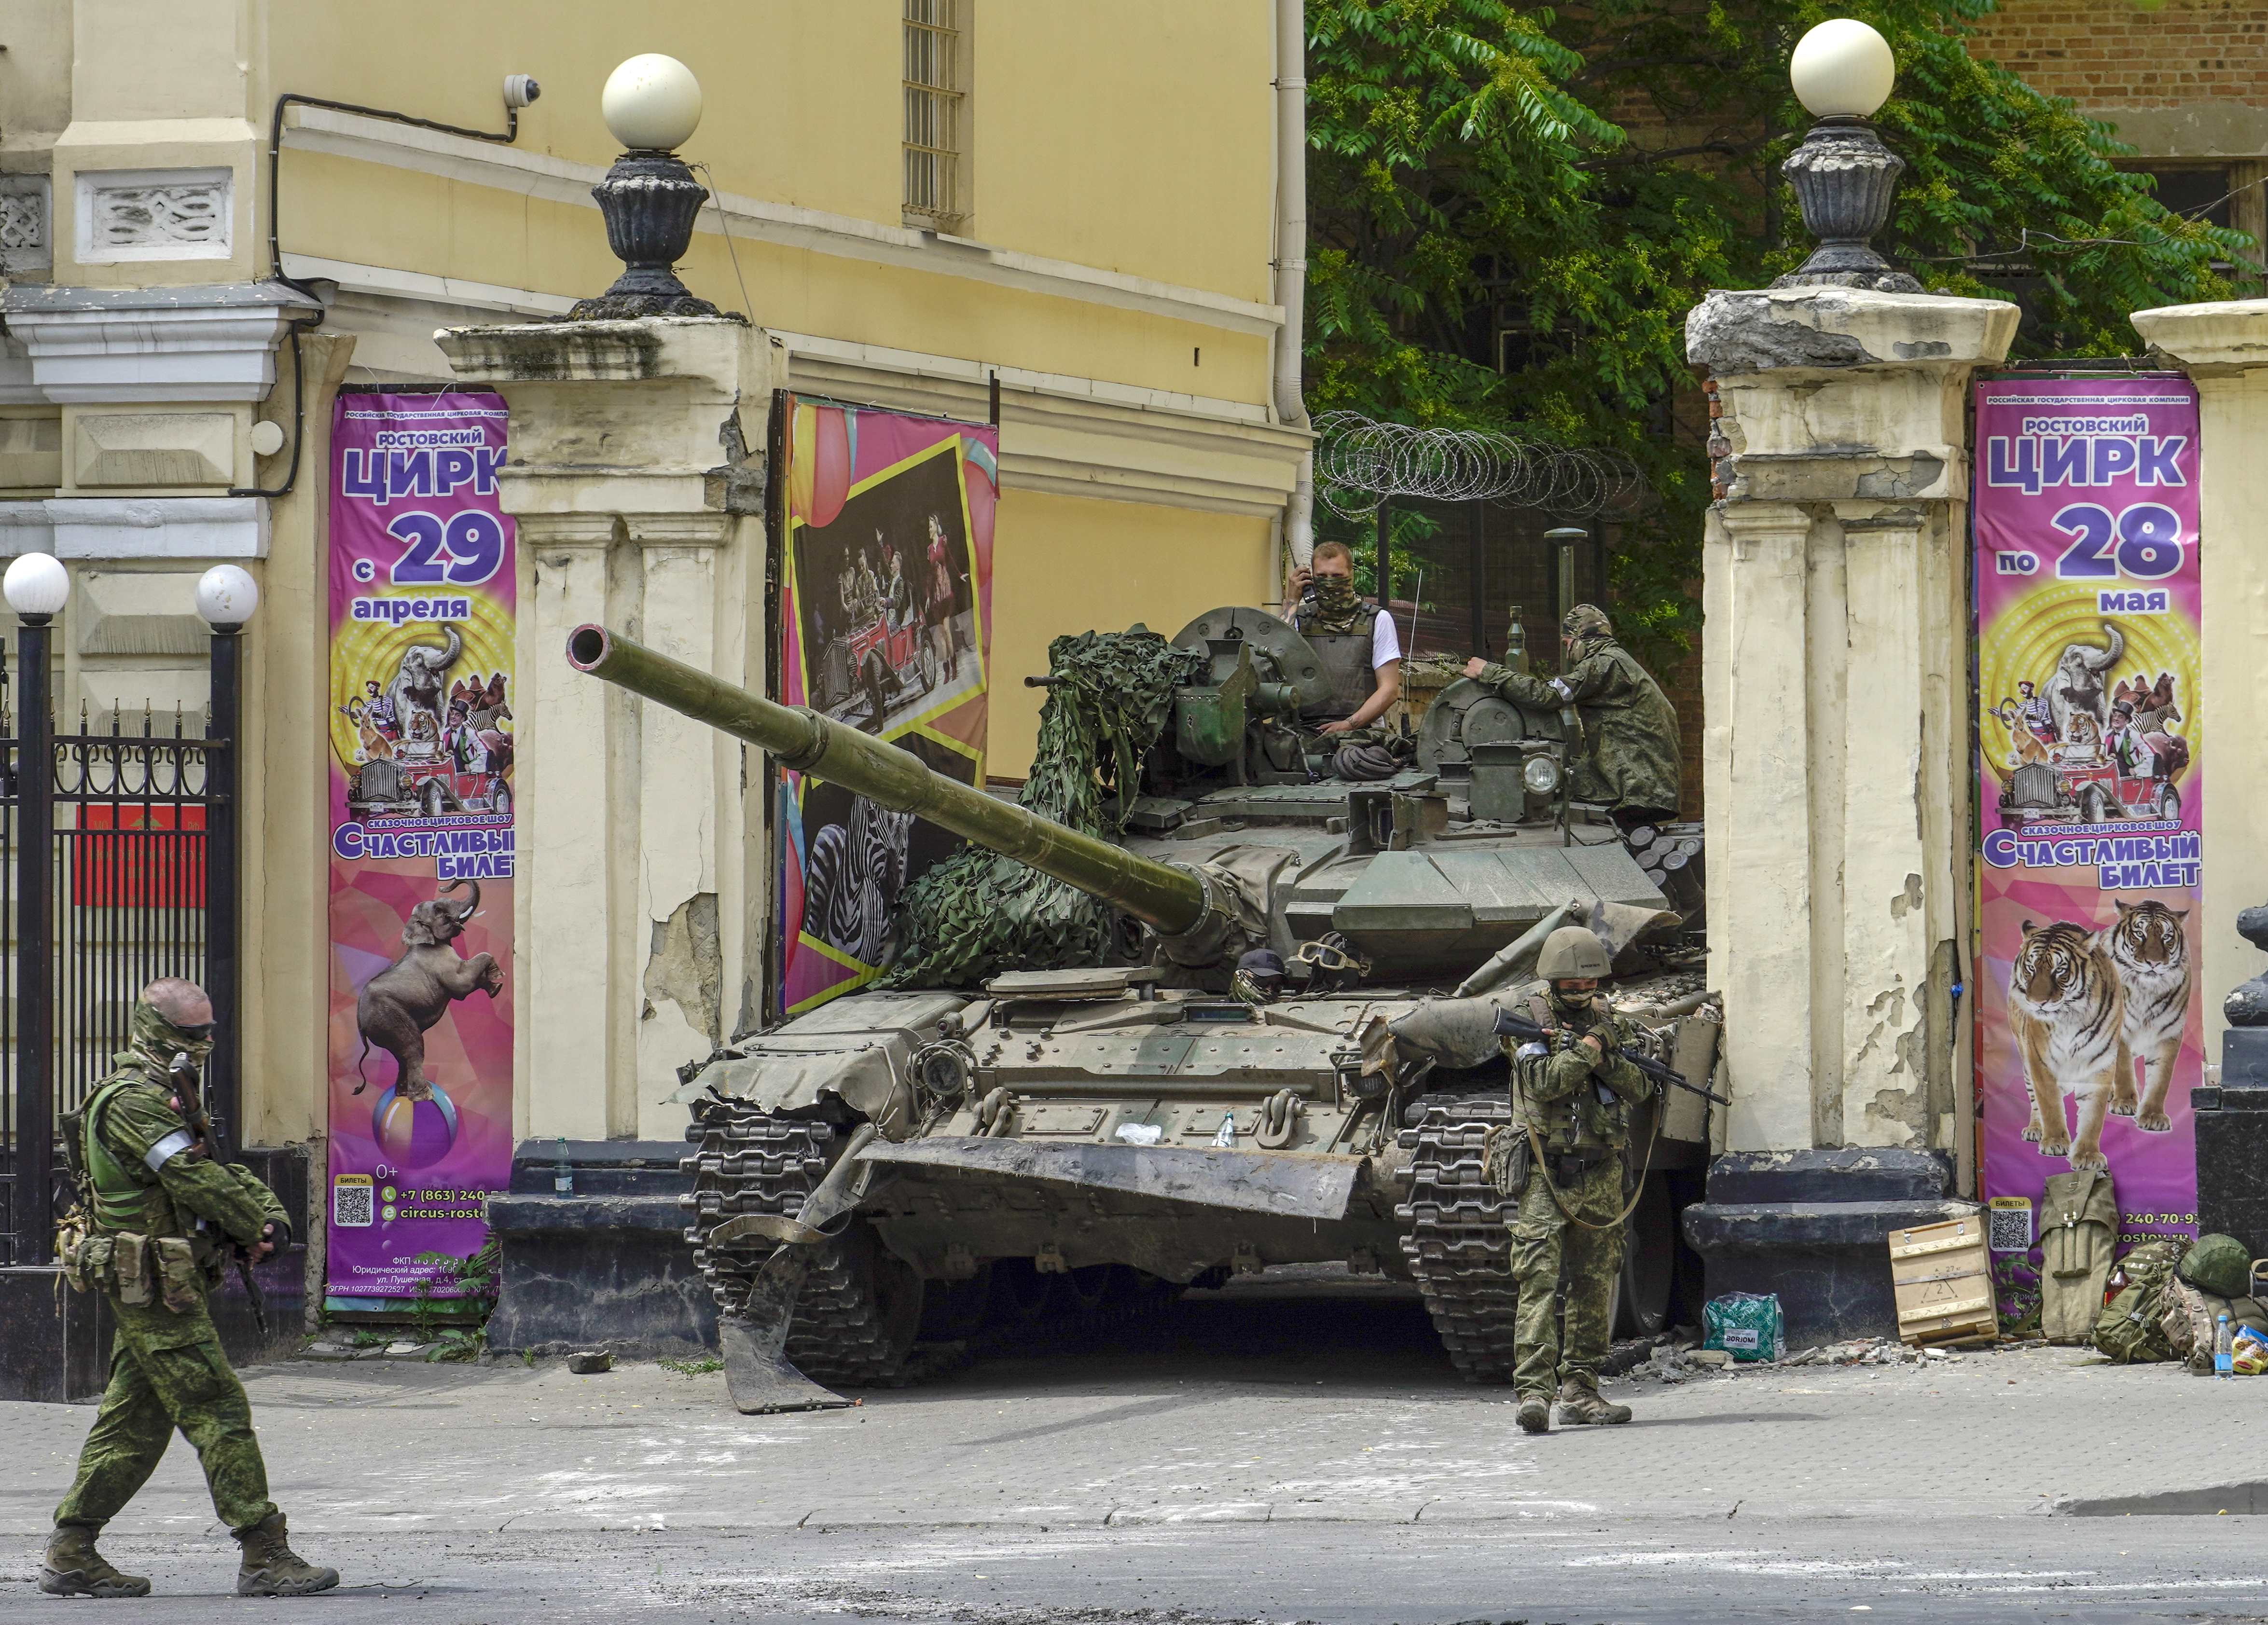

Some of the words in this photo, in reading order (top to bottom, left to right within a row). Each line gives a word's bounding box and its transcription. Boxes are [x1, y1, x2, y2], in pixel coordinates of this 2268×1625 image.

[2025, 416, 2146, 432] РОСТОВСКИЙ
[378, 428, 483, 446] РОСТОВСКИЙ
[1990, 438, 2184, 493] ЦИРК
[344, 449, 508, 503] ЦИРК
[355, 561, 372, 579] с
[388, 512, 501, 583] 29
[1999, 553, 2036, 572] по
[2054, 506, 2181, 577] 28
[2100, 592, 2166, 611] мая
[353, 598, 468, 624] апреля
[368, 817, 428, 827] СКАЗОЧНОЕ
[430, 816, 485, 827] ЦИРКОВОЕ
[487, 814, 512, 823] ШОУ
[2022, 825, 2089, 835] СКАЗОЧНОЕ
[2092, 823, 2153, 834] ЦИРКОВОЕ
[2154, 820, 2182, 829] ШОУ
[438, 855, 514, 878] БИЛЕ
[2101, 862, 2200, 888] БИЛЕТ
[376, 1164, 398, 1179] 0+
[400, 1190, 416, 1200] +7
[420, 1190, 456, 1203] (863)
[352, 1265, 408, 1275] Юридический
[435, 1276, 451, 1284] д.4,
[1936, 1283, 1943, 1294] 2
[1726, 1335, 1755, 1344] BORJOMI
